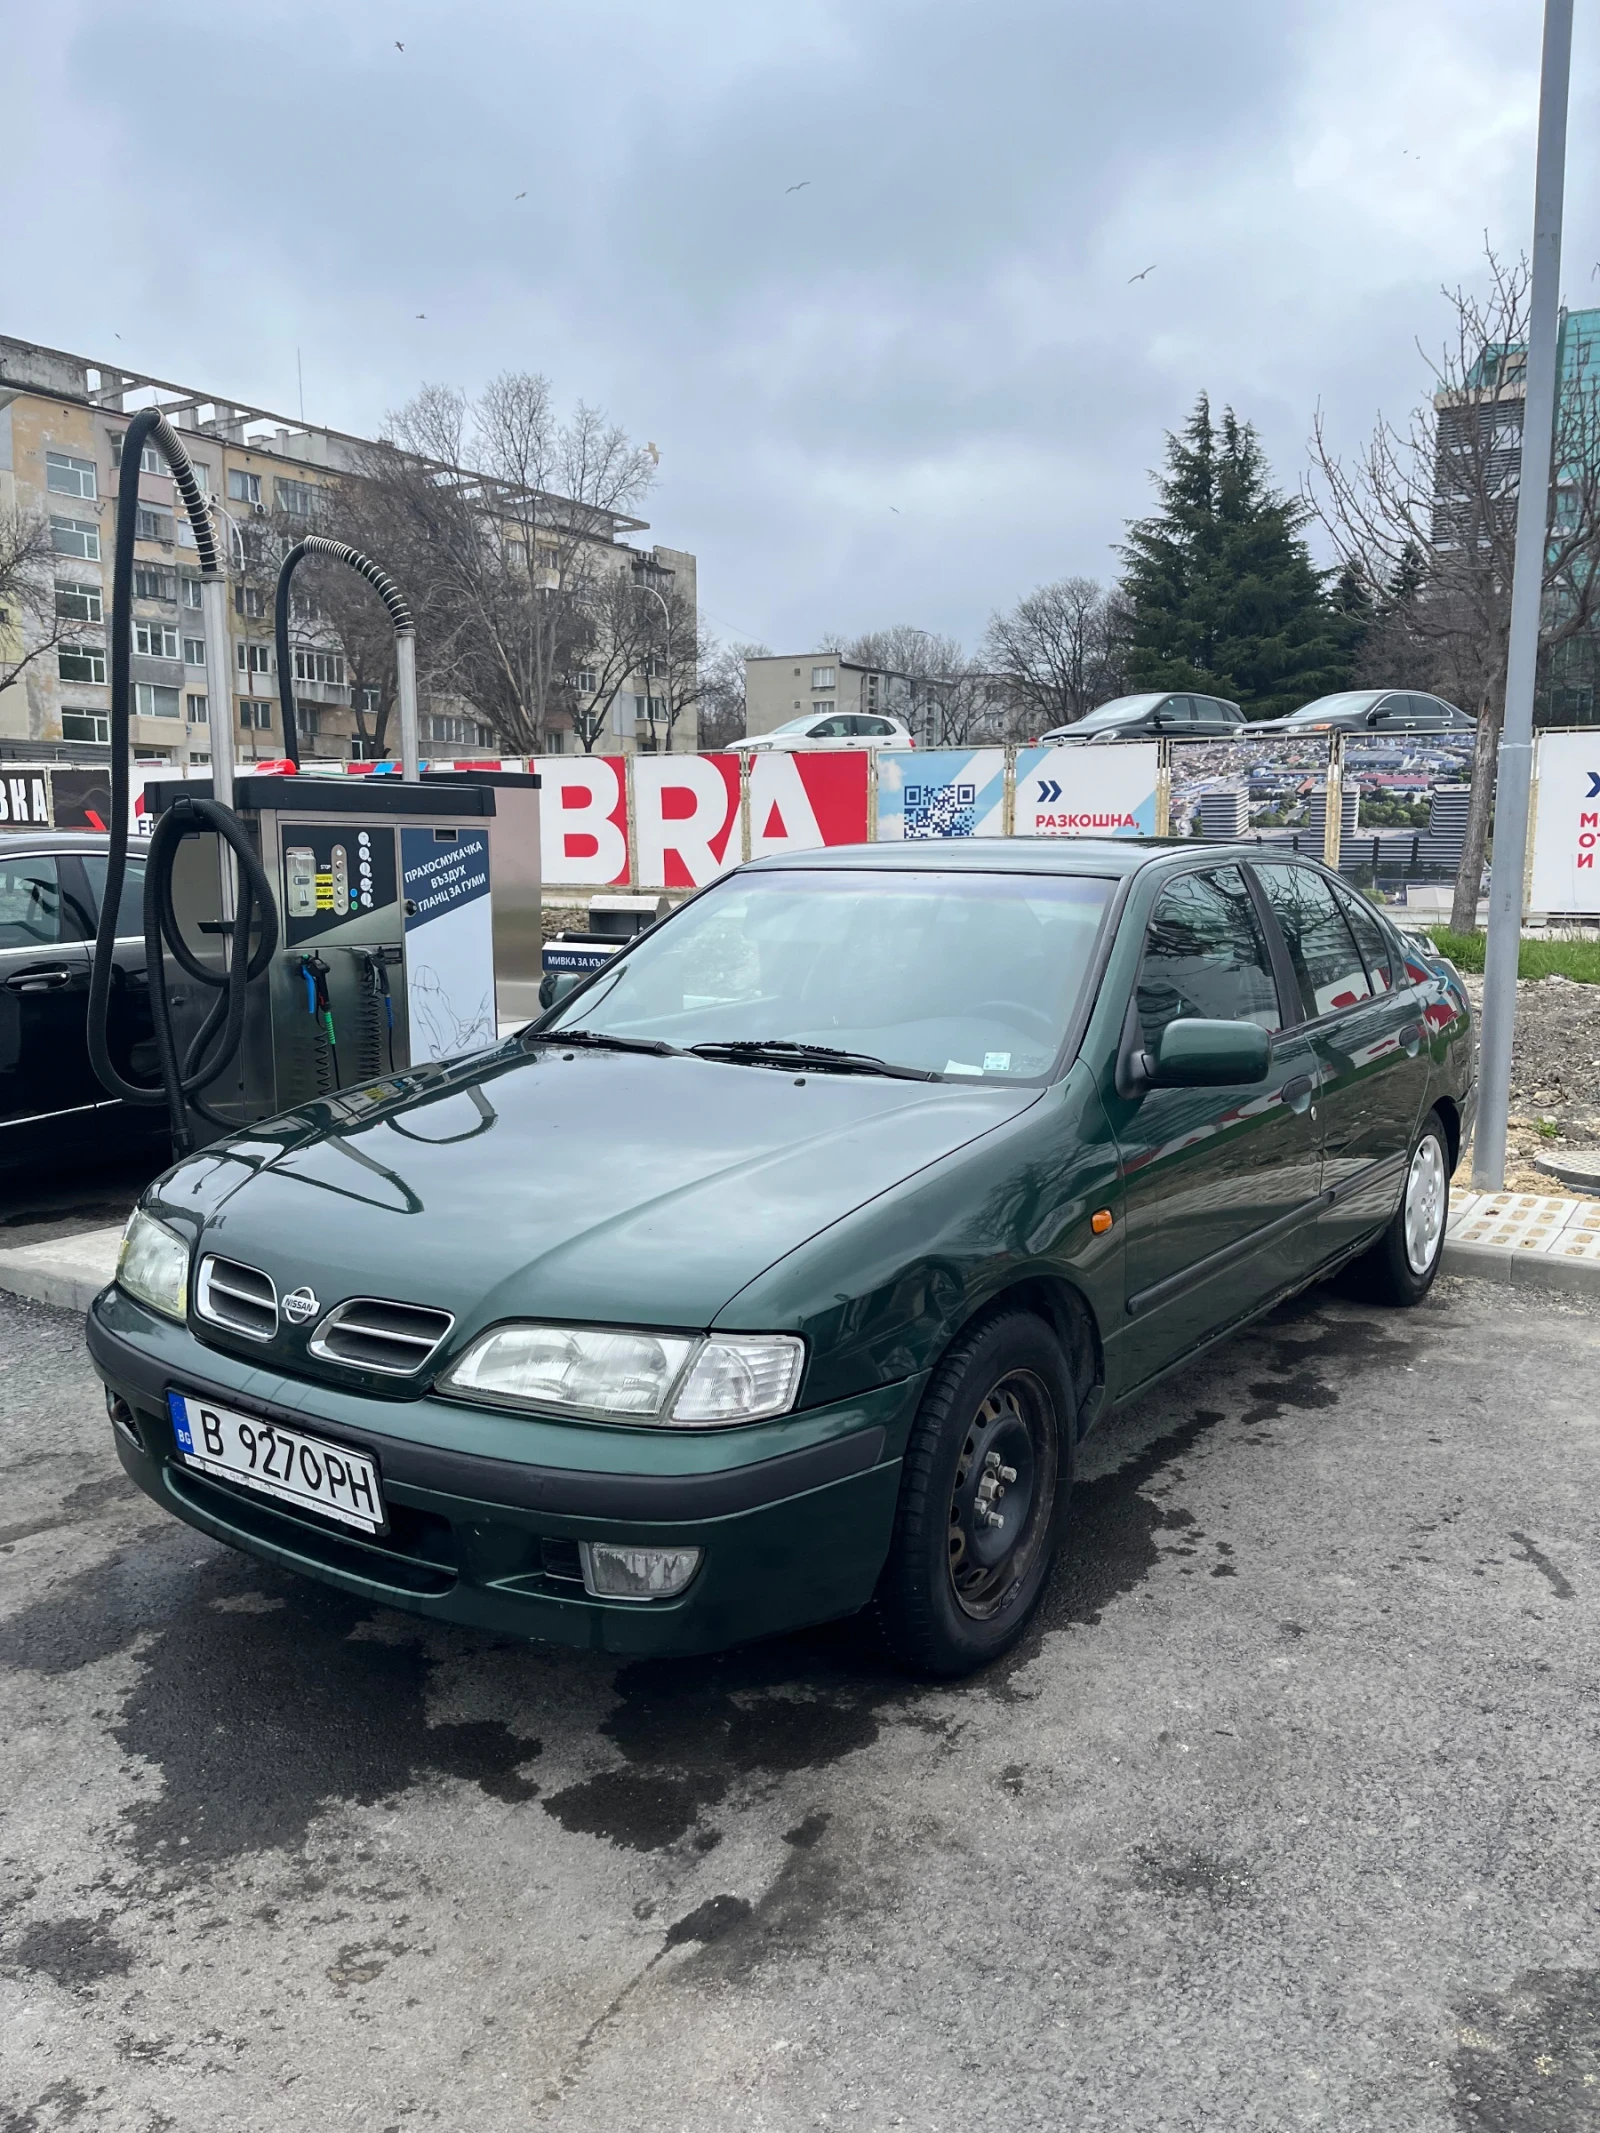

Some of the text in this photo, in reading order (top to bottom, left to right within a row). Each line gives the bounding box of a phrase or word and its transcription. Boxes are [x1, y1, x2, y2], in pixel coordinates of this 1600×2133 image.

[1035, 813, 1140, 829] РАЗКОШНА,
[1580, 812, 1600, 828] М
[404, 841, 483, 883] ПРАХОСМУКАЧКА
[430, 864, 466, 889] ВЪЗДУХ
[418, 872, 486, 912] ГЛАНЦ ЗА ГУМИ
[548, 956, 606, 967] МИВКА ЗА КЪР
[285, 1298, 313, 1312] NISSAN
[177, 1429, 191, 1444] BG
[200, 1409, 224, 1456] B
